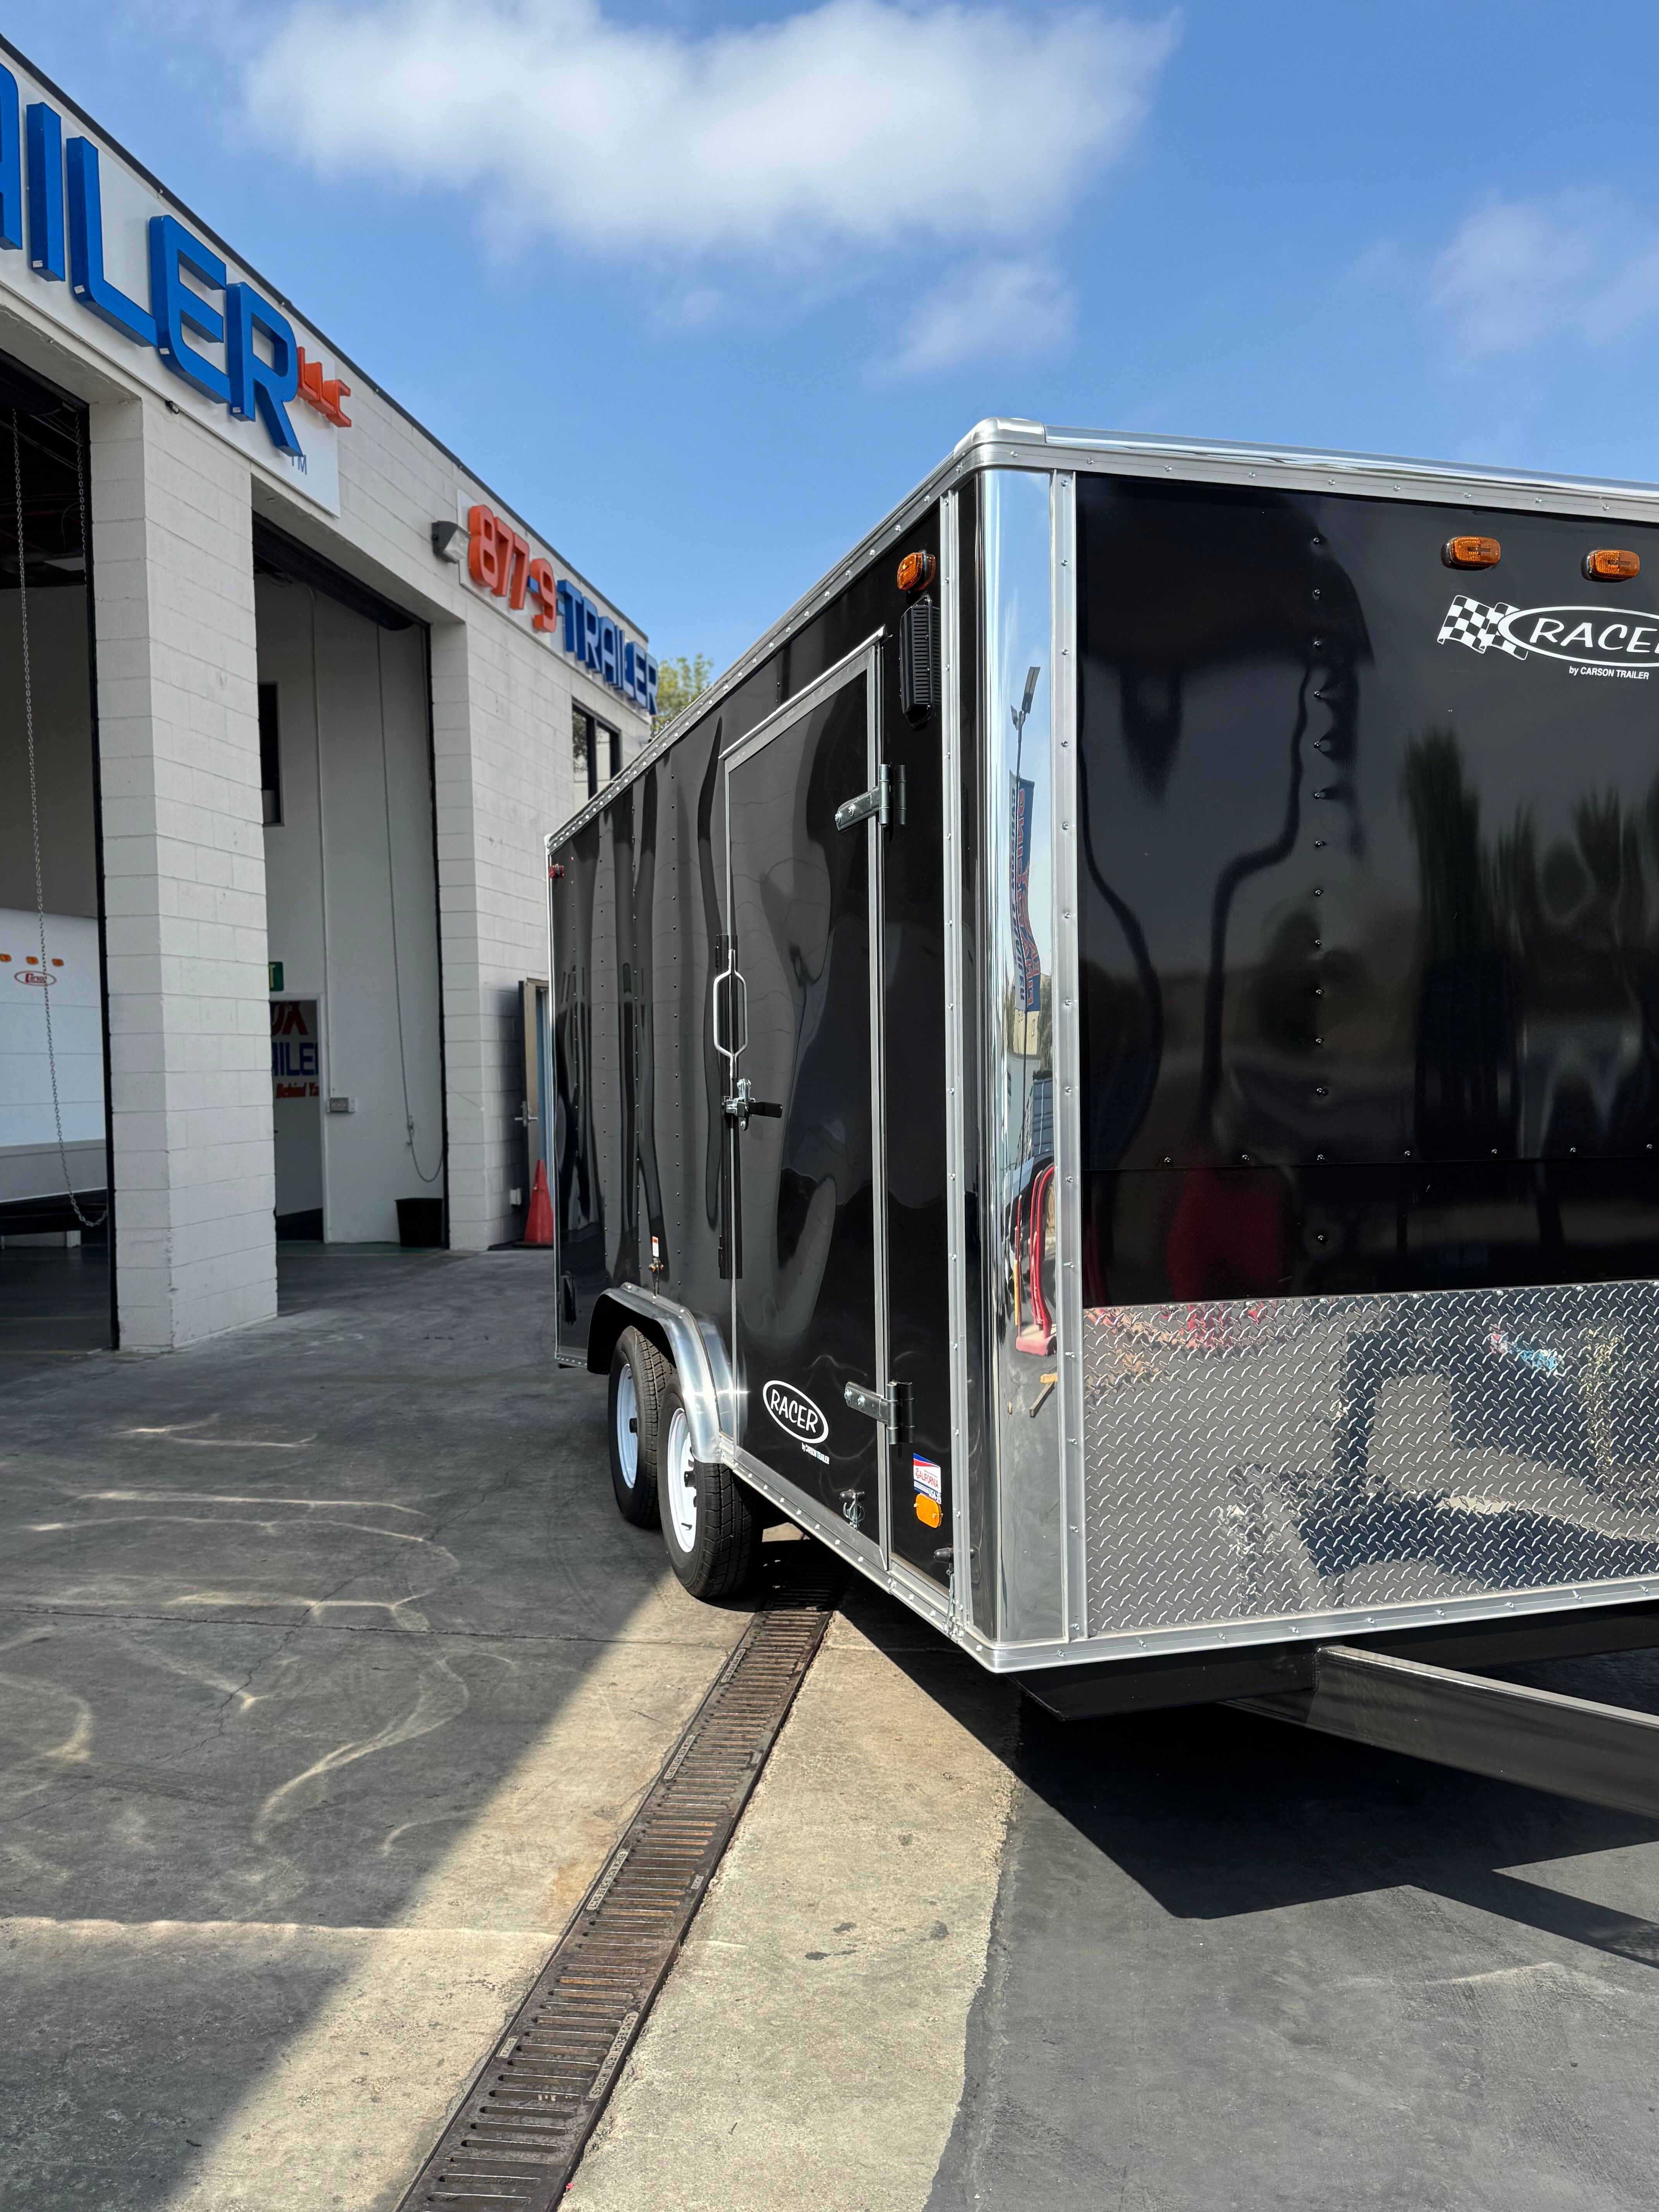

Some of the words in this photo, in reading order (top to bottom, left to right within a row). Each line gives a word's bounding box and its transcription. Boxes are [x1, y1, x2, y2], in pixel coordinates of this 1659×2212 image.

[297, 347, 352, 428] LLC
[1530, 618, 1659, 654] RACE
[1569, 666, 1578, 676] by
[1580, 666, 1614, 677] CARSON
[1616, 669, 1649, 680] TRAILER
[771, 1389, 818, 1433] RACER
[622, 2015, 636, 2031] LONG
[613, 2032, 629, 2052] BEACH
[603, 2055, 618, 2070] IRON
[591, 2073, 610, 2096] WORKS
